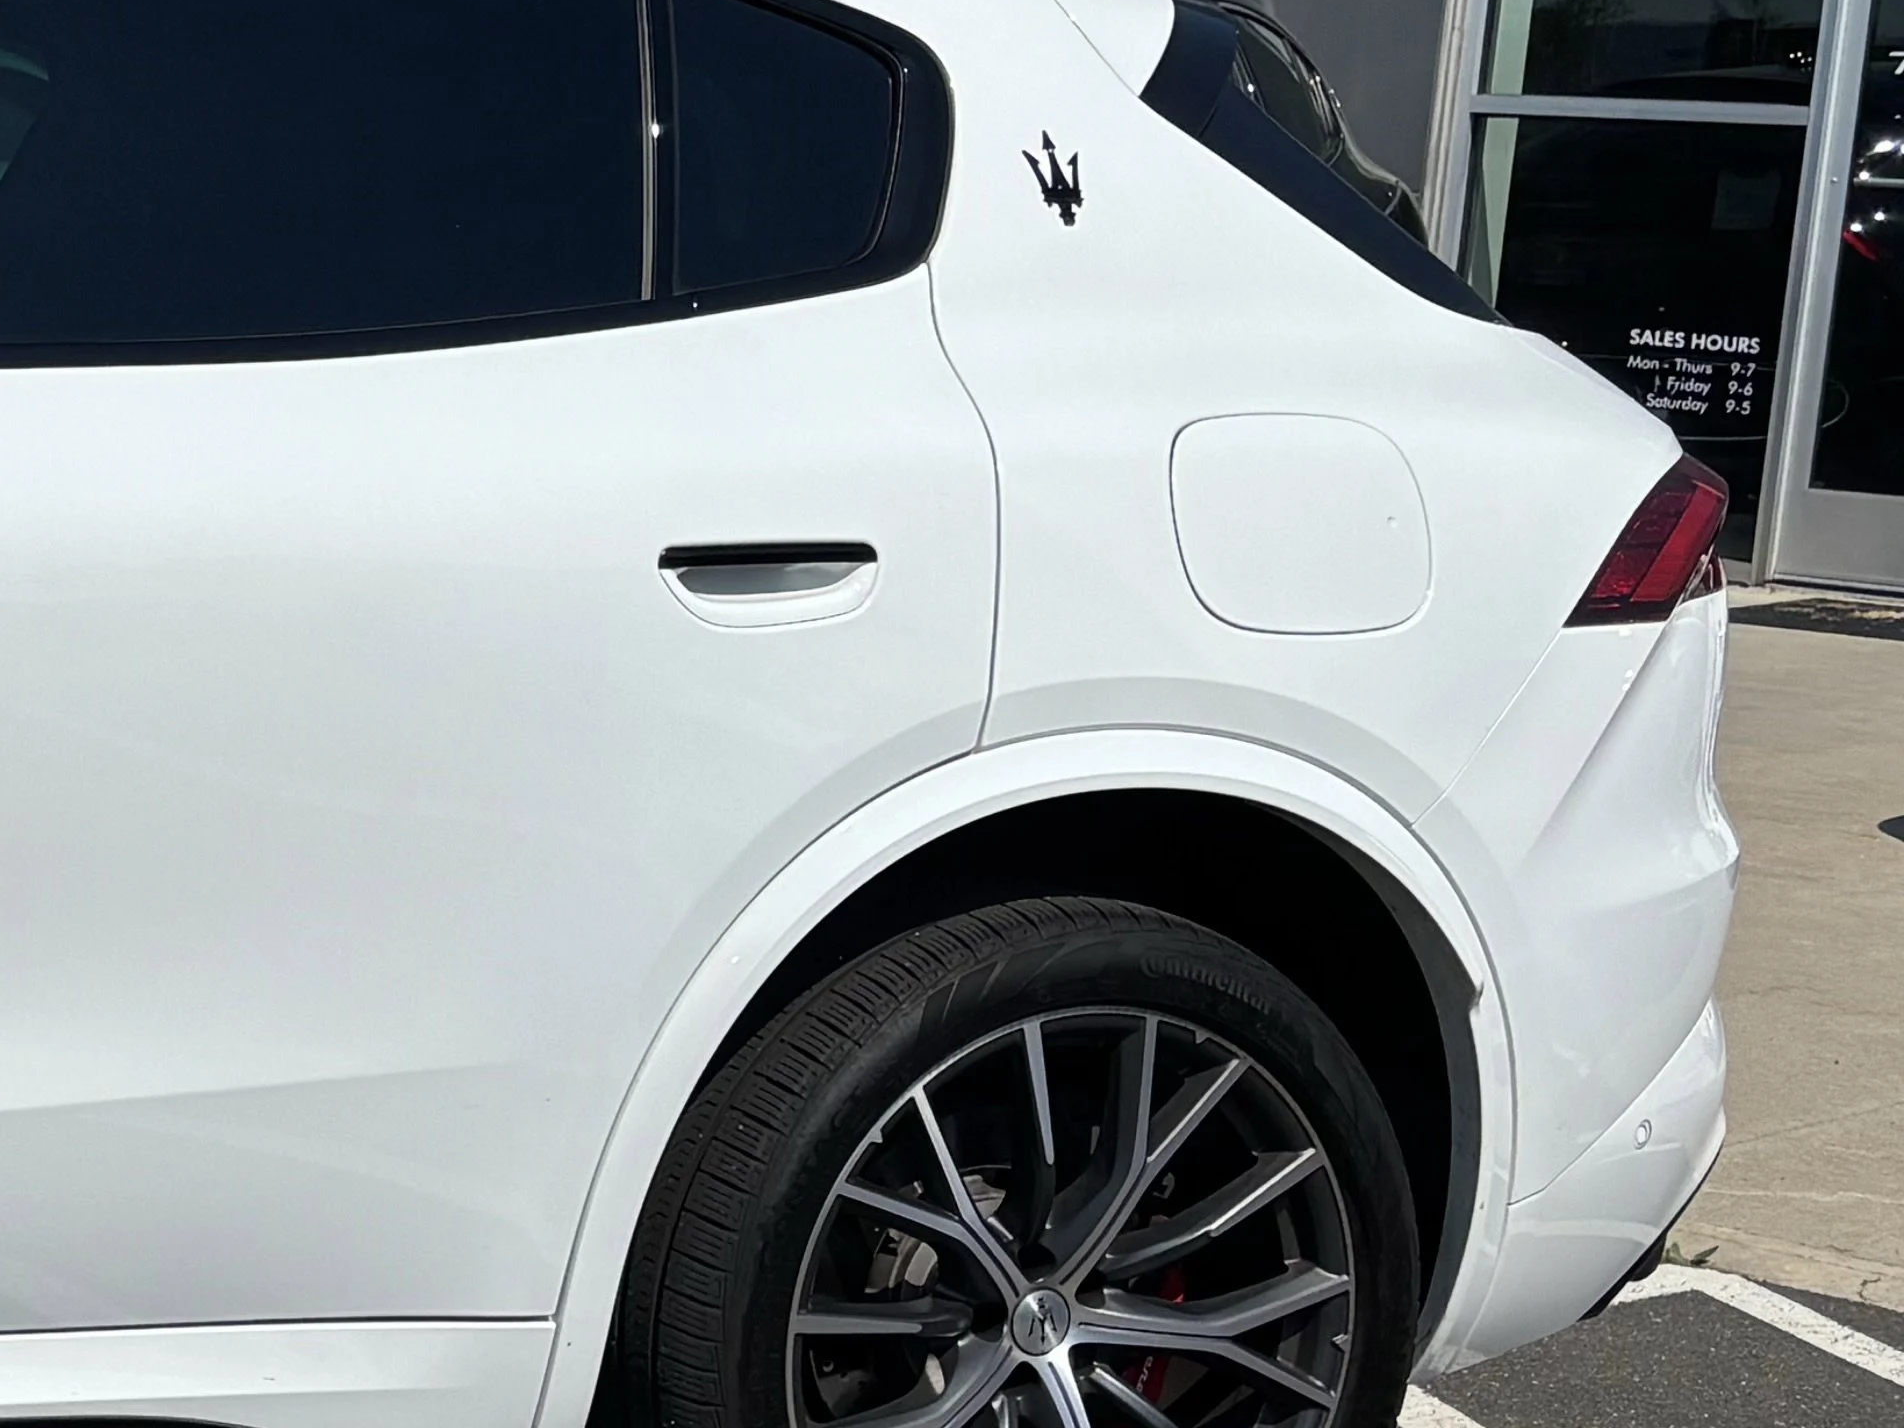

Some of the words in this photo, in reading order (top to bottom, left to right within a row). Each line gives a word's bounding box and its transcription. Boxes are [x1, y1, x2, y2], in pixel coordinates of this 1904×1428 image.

[1629, 329, 1685, 349] SALES
[1691, 333, 1760, 354] HOURS
[1627, 355, 1659, 370] Mon
[1674, 358, 1712, 375] Thurs
[1731, 362, 1756, 378] 9-7
[1666, 377, 1711, 395] Friday
[1728, 381, 1753, 396] 9-6
[1646, 394, 1708, 414] Saturday
[1725, 400, 1751, 415] 9-5
